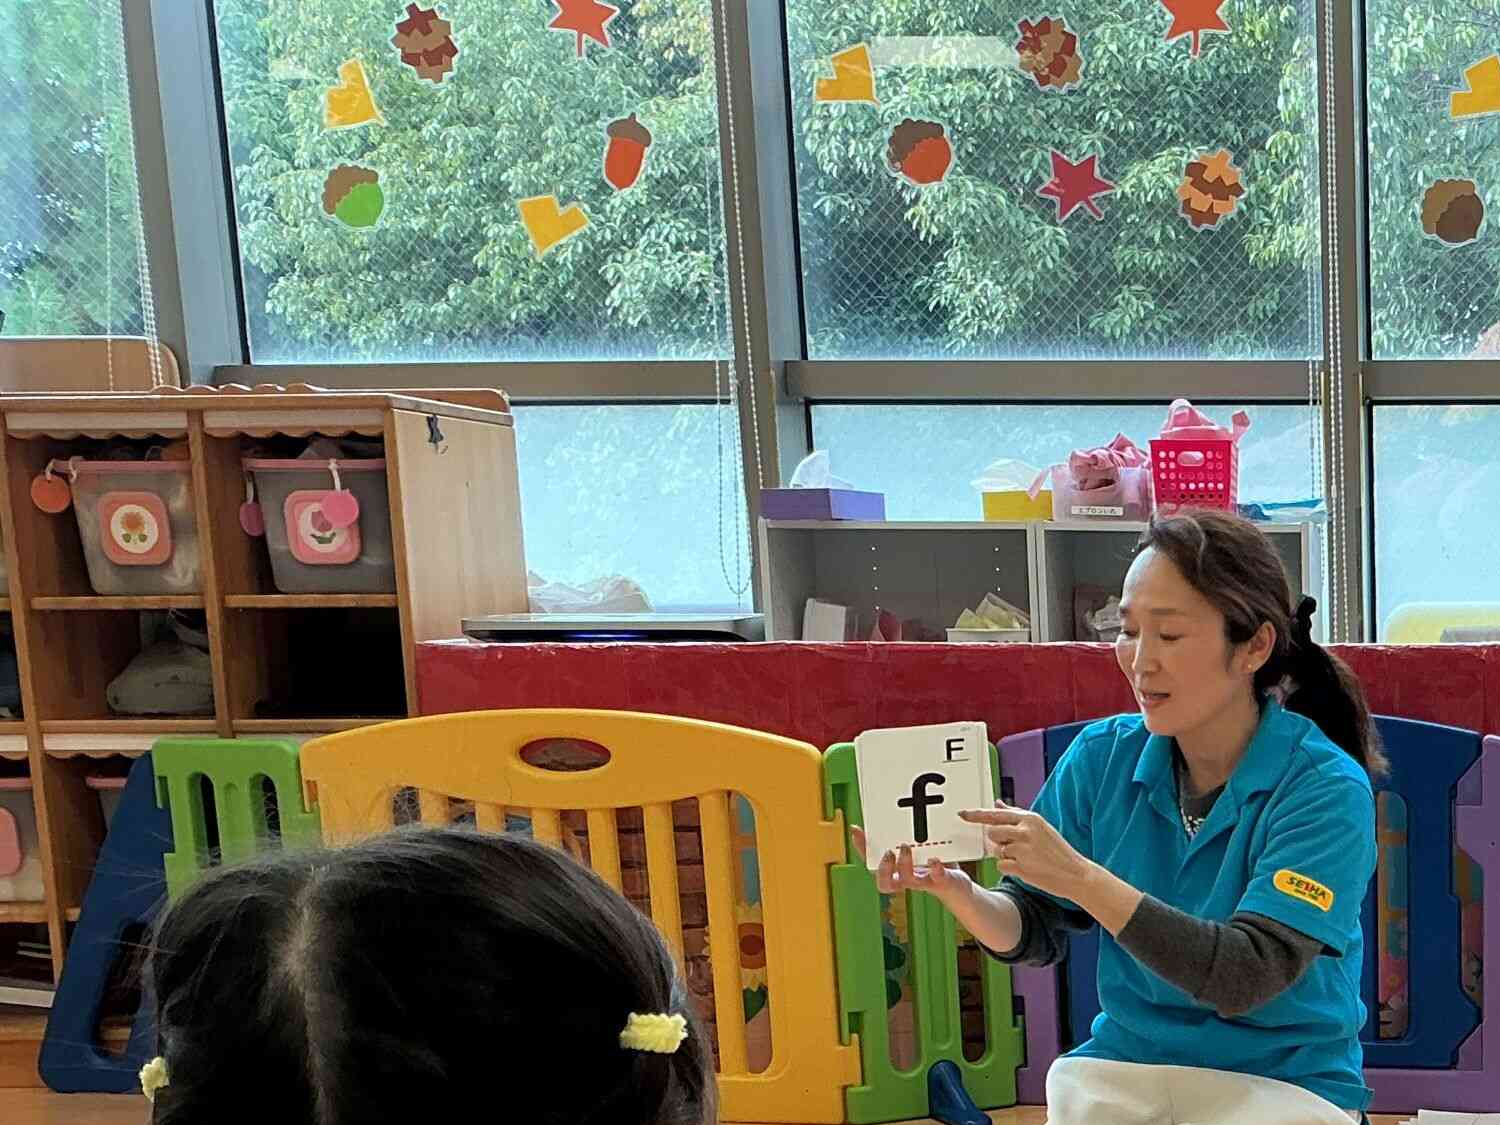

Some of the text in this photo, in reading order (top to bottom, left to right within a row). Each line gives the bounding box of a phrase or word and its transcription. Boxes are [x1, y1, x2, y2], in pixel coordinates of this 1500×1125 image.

[946, 738, 965, 761] F
[897, 773, 946, 843] f
[1286, 876, 1327, 900] SEIHA
